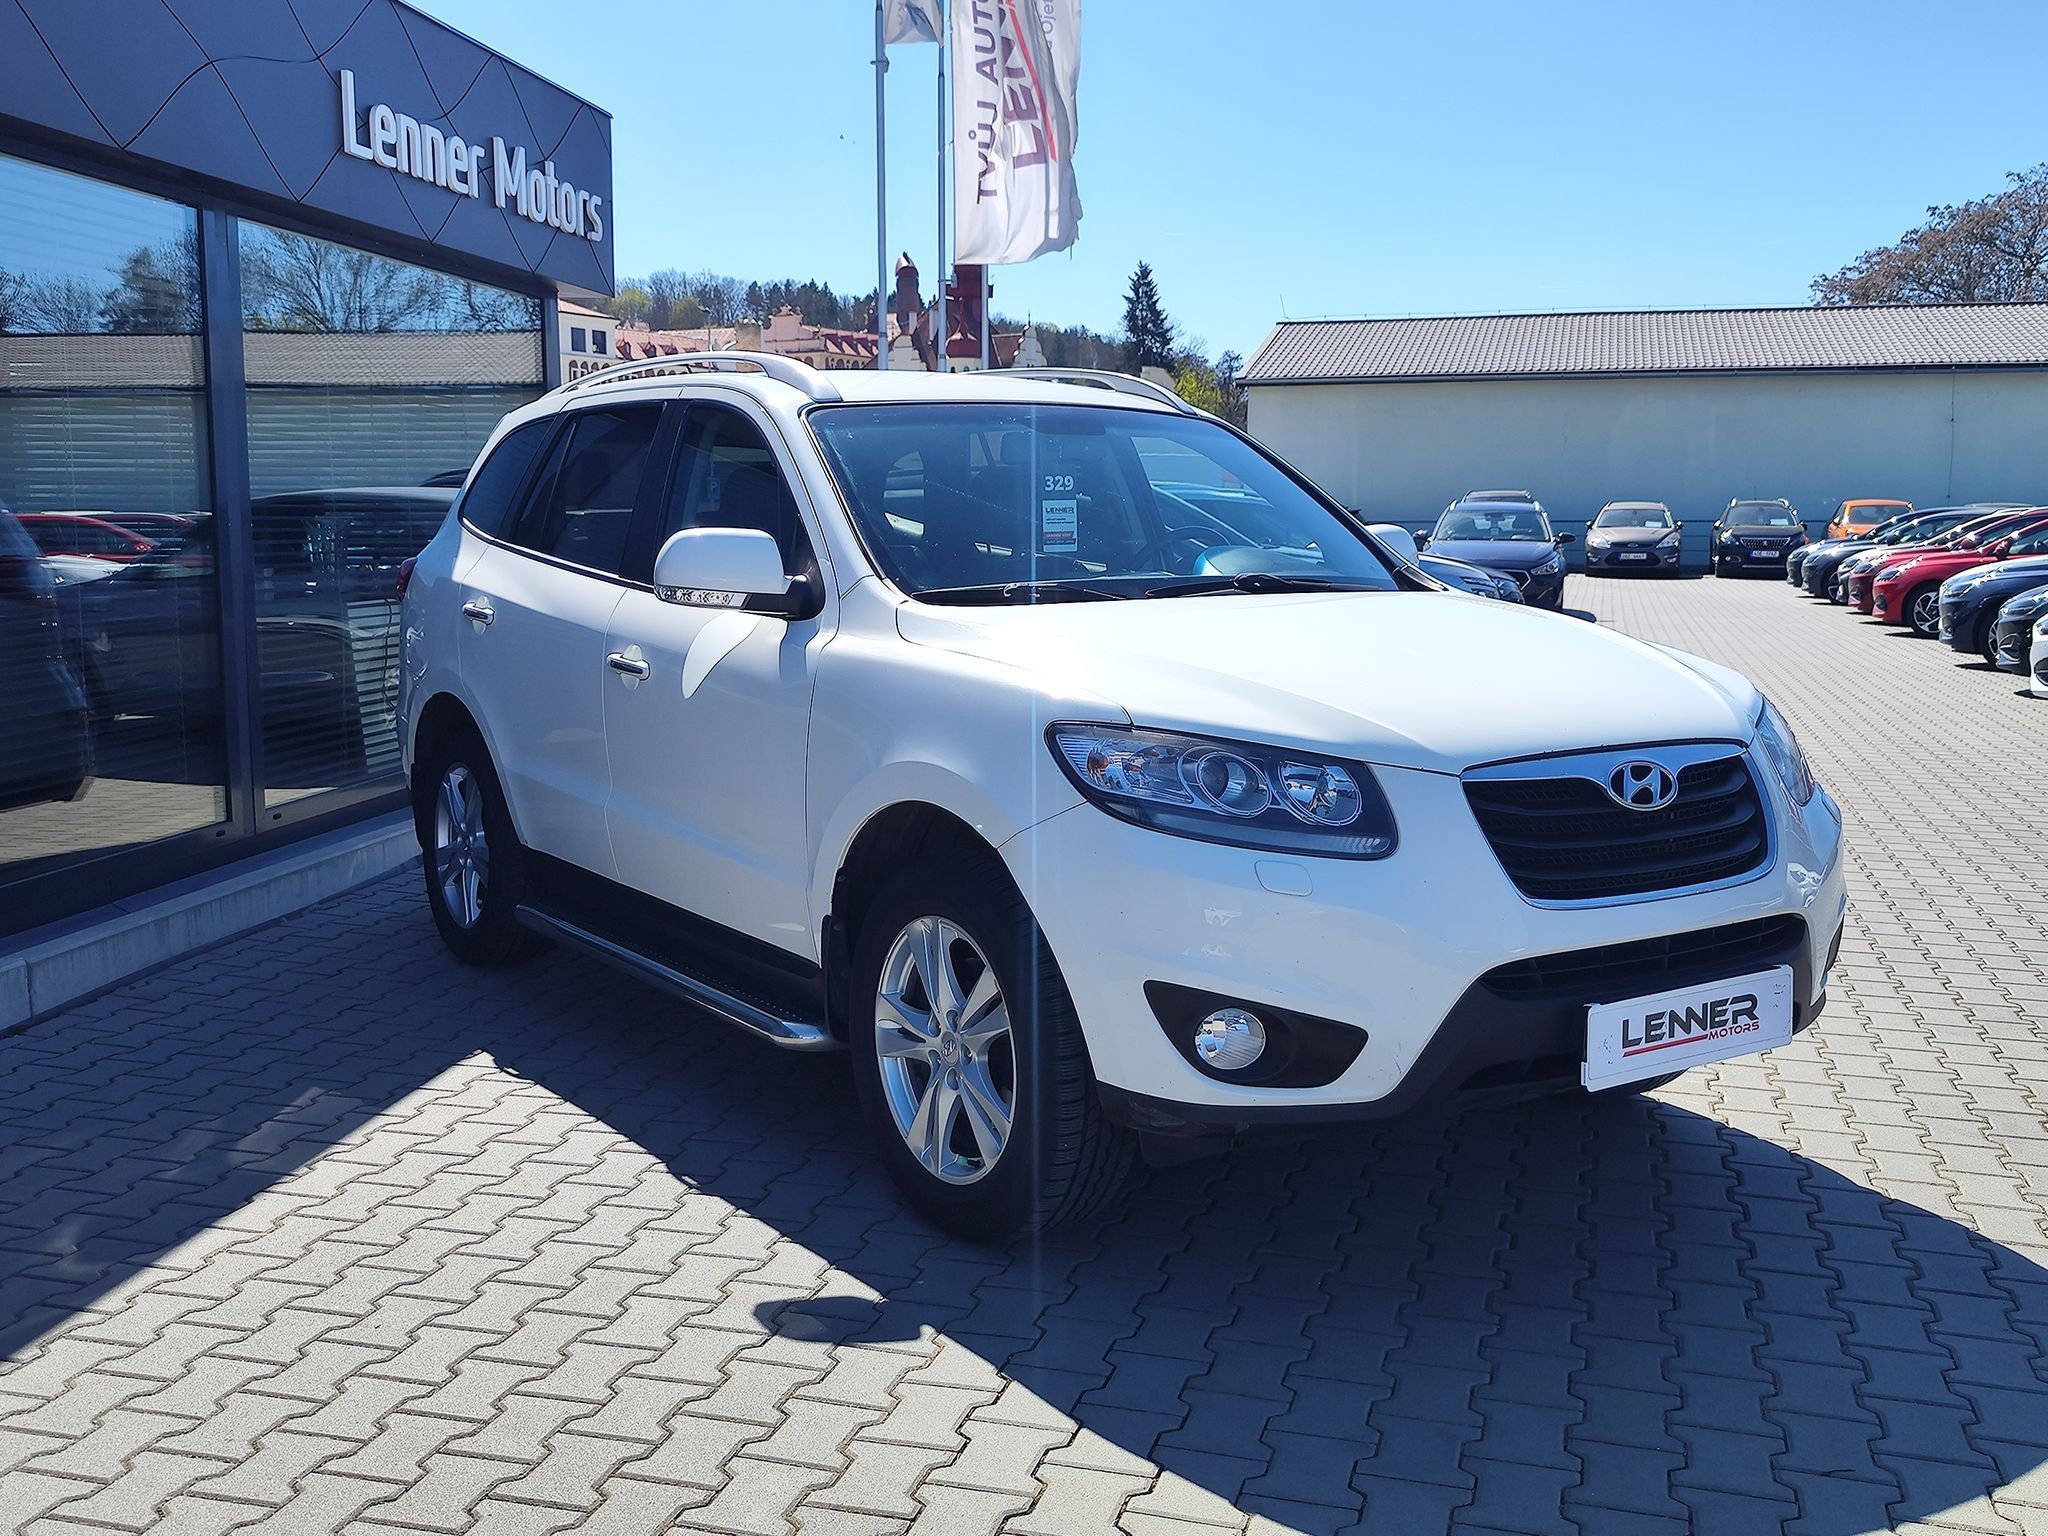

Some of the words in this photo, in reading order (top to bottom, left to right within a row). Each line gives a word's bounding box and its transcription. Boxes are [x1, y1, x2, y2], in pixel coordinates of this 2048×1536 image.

[340, 69, 485, 199] Lenner
[492, 136, 603, 242] Motors
[968, 100, 998, 204] TVŮJ
[1044, 475, 1074, 491] 329
[1621, 993, 1759, 1049] LENNER
[1708, 1021, 1761, 1041] MOTORS
